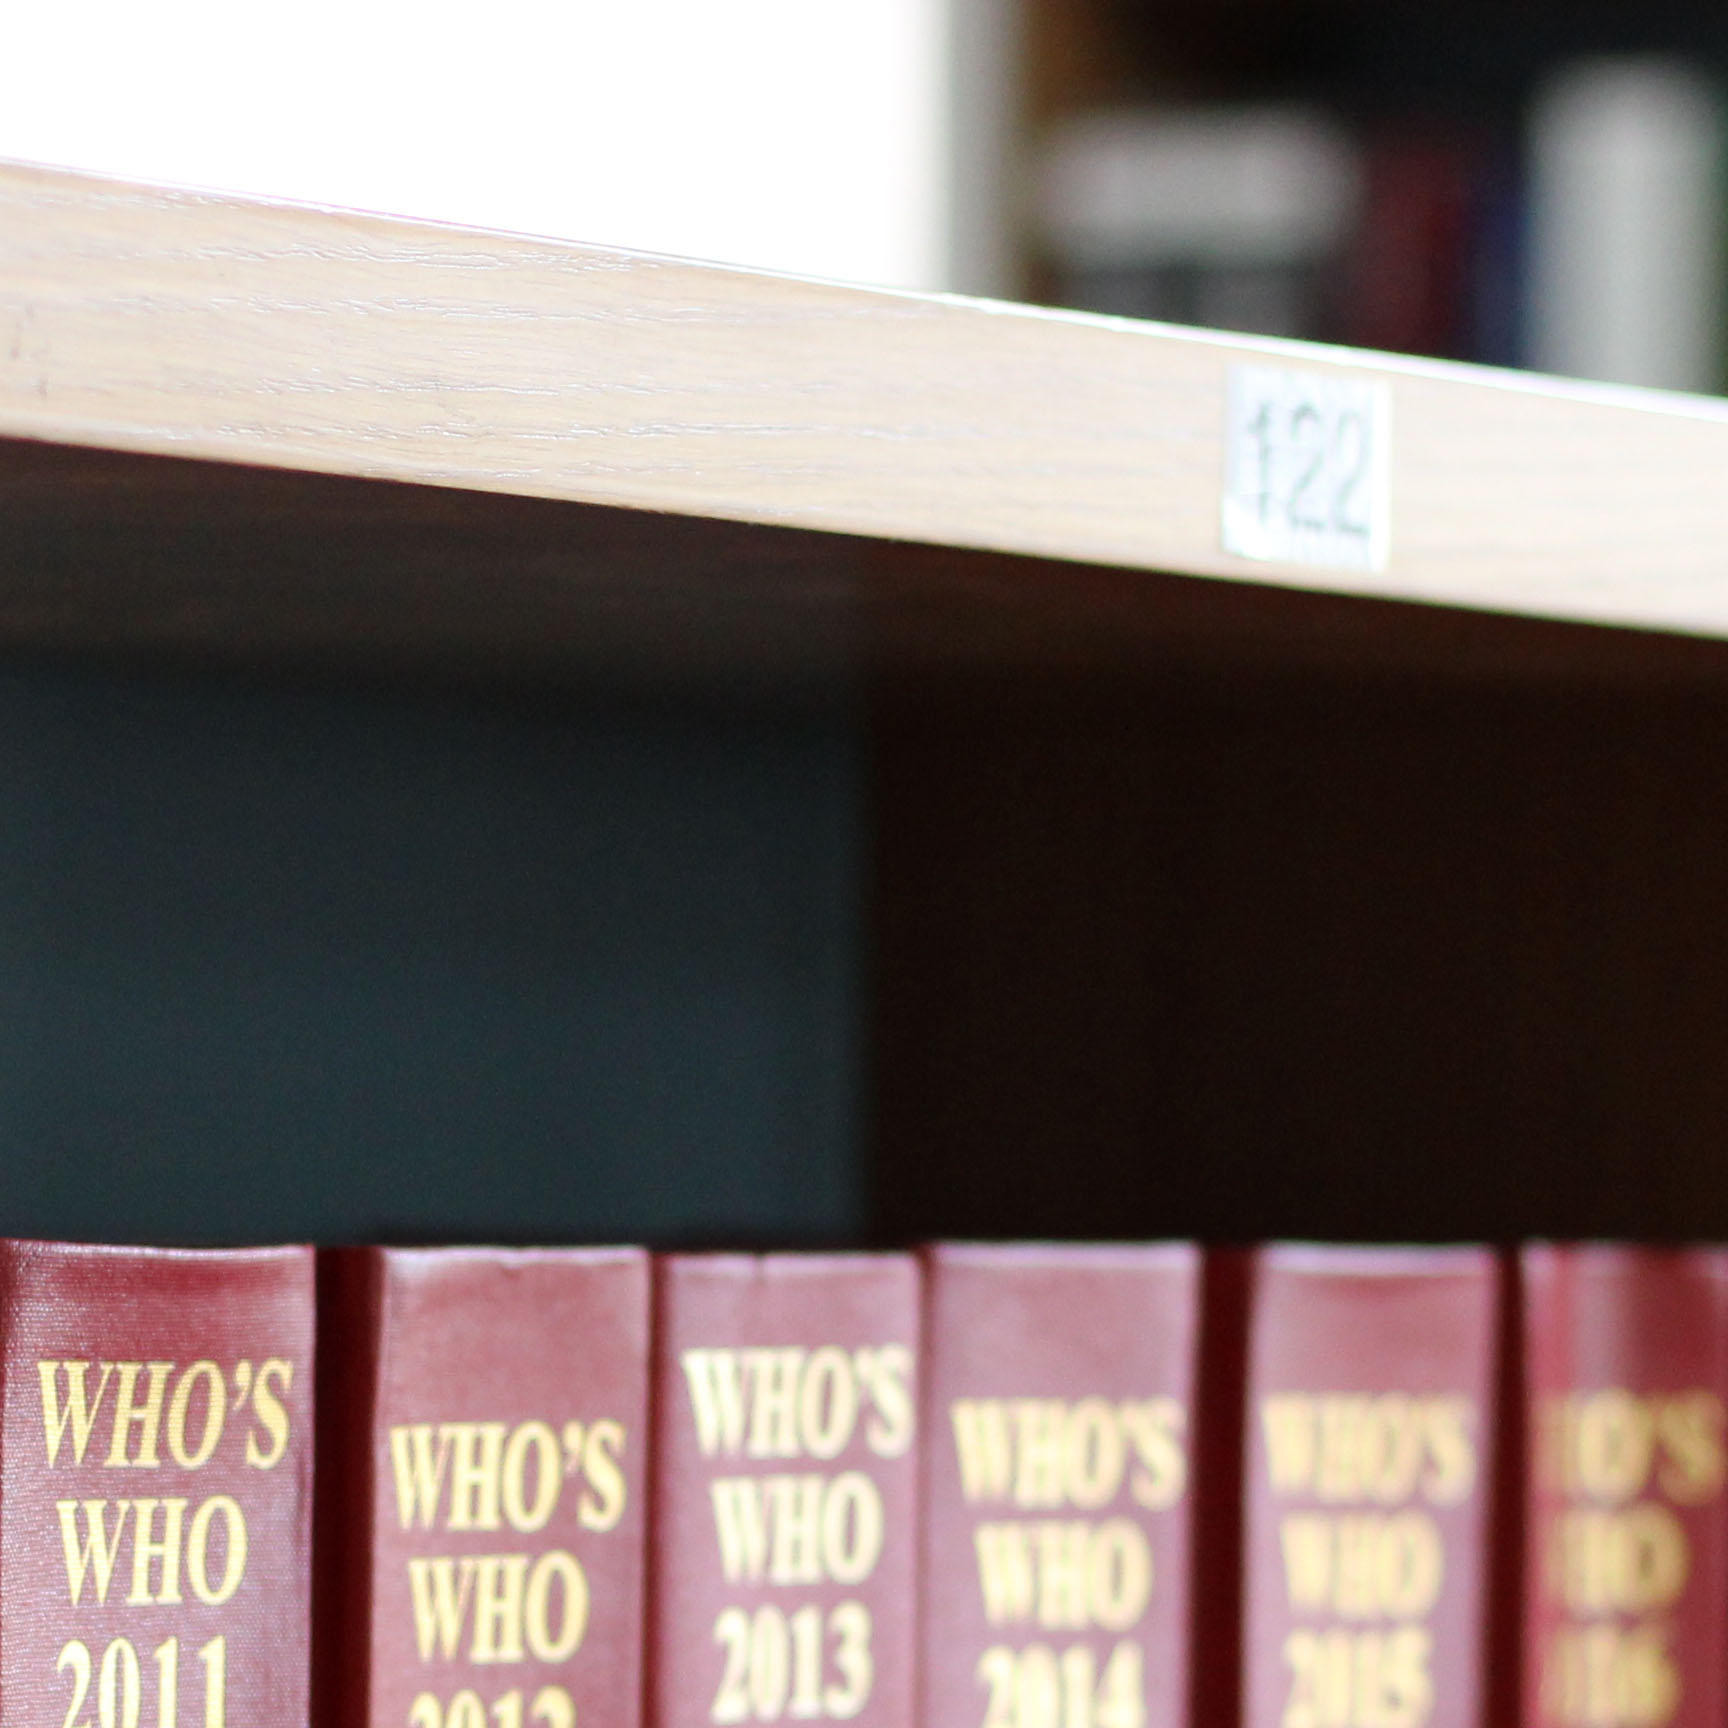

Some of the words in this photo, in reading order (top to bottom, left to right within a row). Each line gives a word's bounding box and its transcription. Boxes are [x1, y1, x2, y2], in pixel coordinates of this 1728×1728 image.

[1246, 401, 1370, 538] 122
[37, 1357, 293, 1470] WHO'S
[680, 1343, 915, 1461] WHO'S
[950, 1397, 1186, 1511] WHO'S
[390, 1418, 628, 1532] WHO'S
[710, 1470, 885, 1587] WHO
[55, 1496, 248, 1608] WHO
[409, 1550, 590, 1664] WHO
[976, 1517, 1151, 1631] WHO
[709, 1599, 874, 1725] 2013
